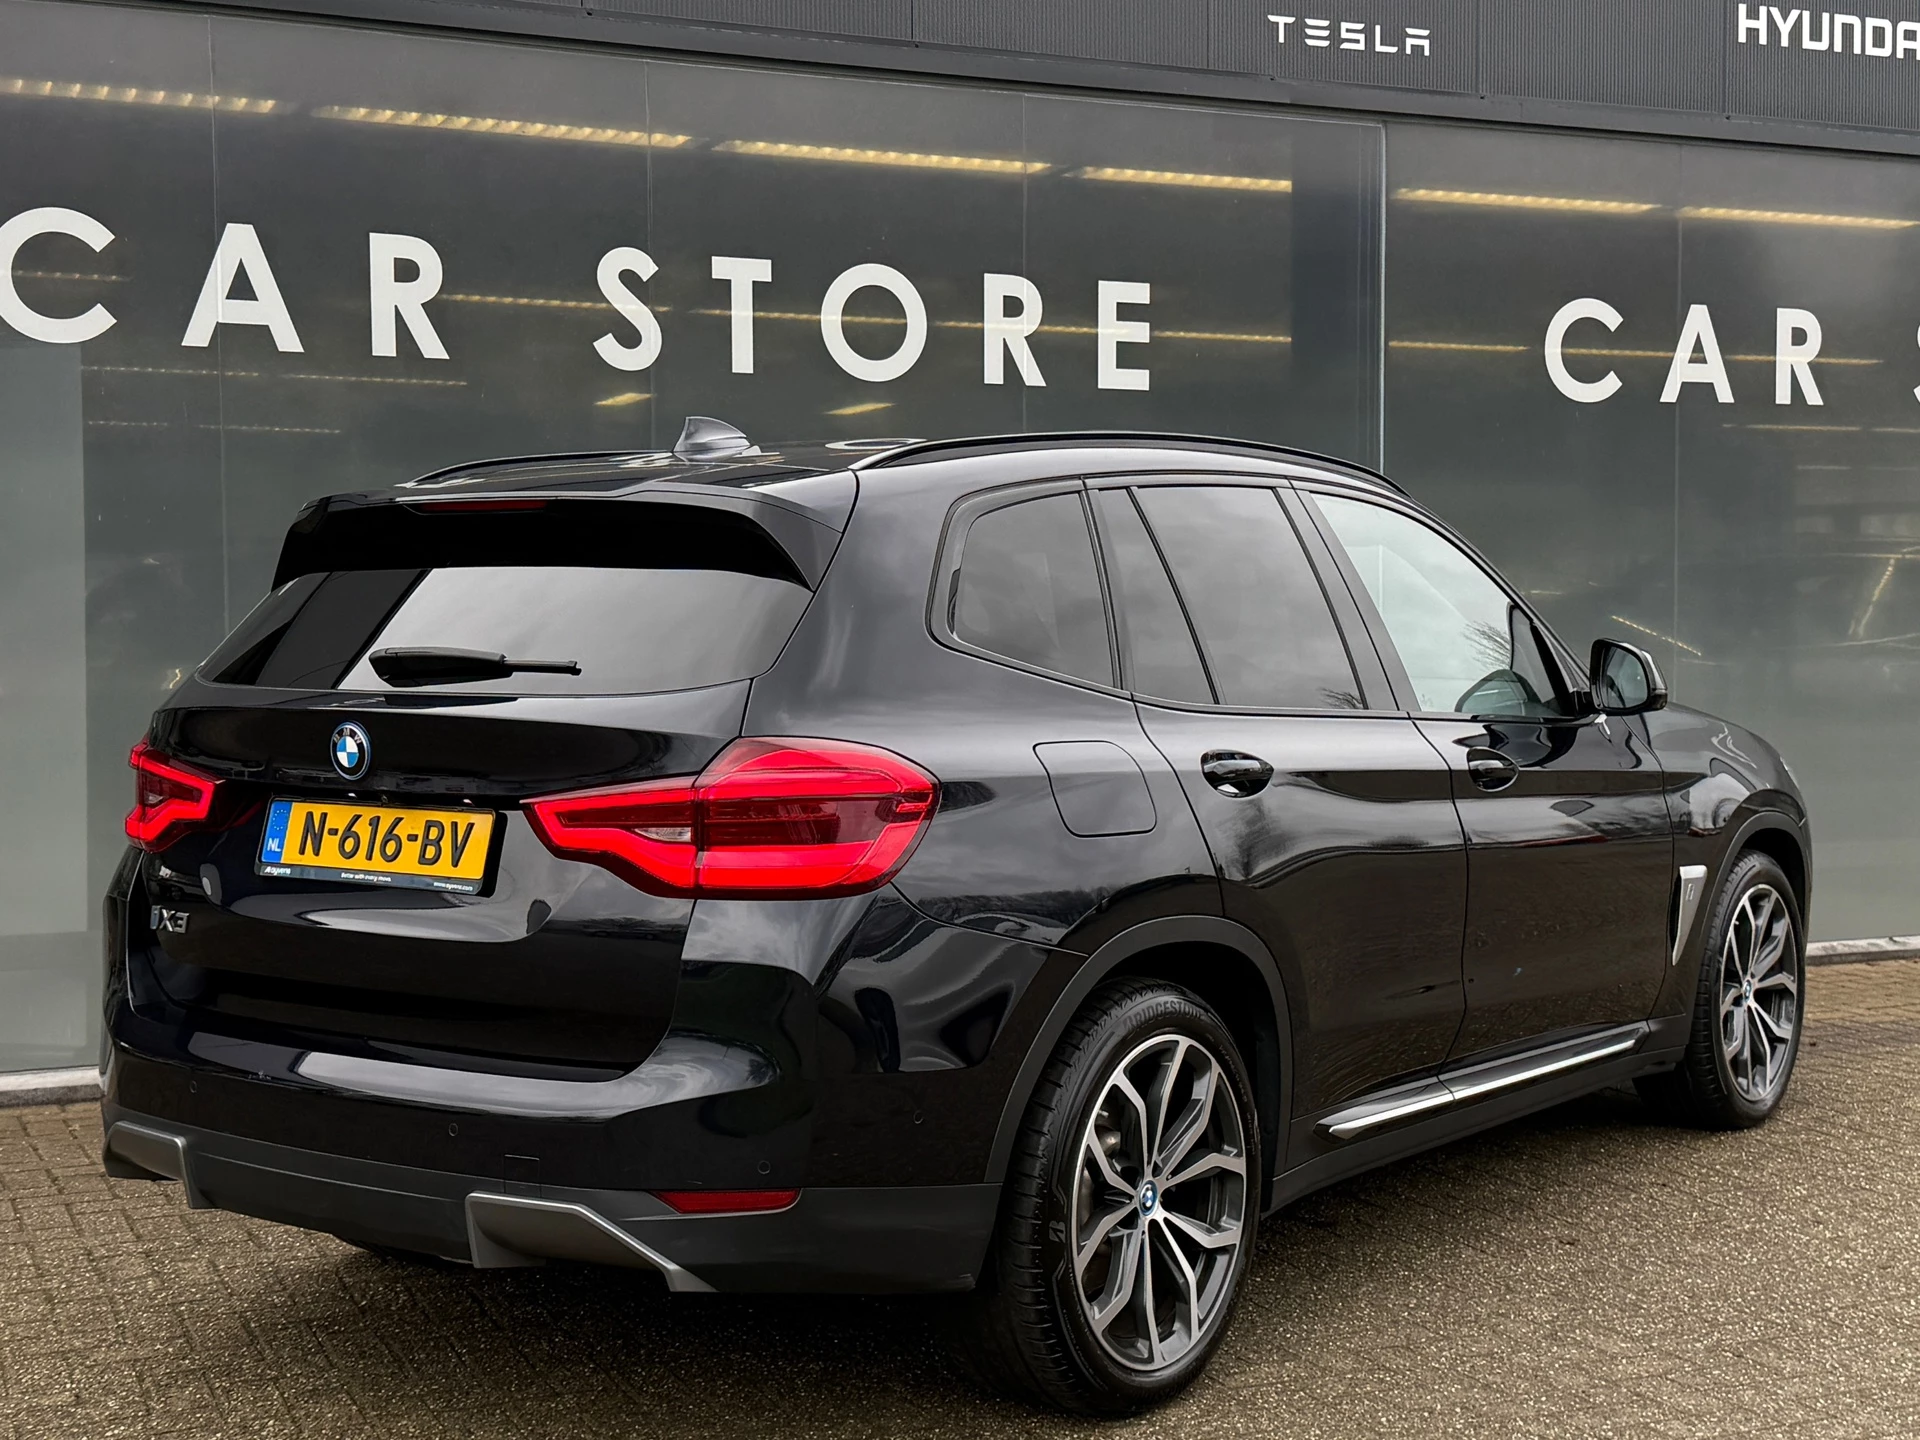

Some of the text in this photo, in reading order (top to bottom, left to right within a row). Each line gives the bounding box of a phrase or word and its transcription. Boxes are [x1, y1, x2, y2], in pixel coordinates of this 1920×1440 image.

[1267, 14, 1431, 57] TESLA
[0, 207, 1151, 391] CAR STORE
[1544, 298, 1824, 406] CAR
[267, 837, 282, 852] NL
[298, 811, 476, 868] N-616-BV
